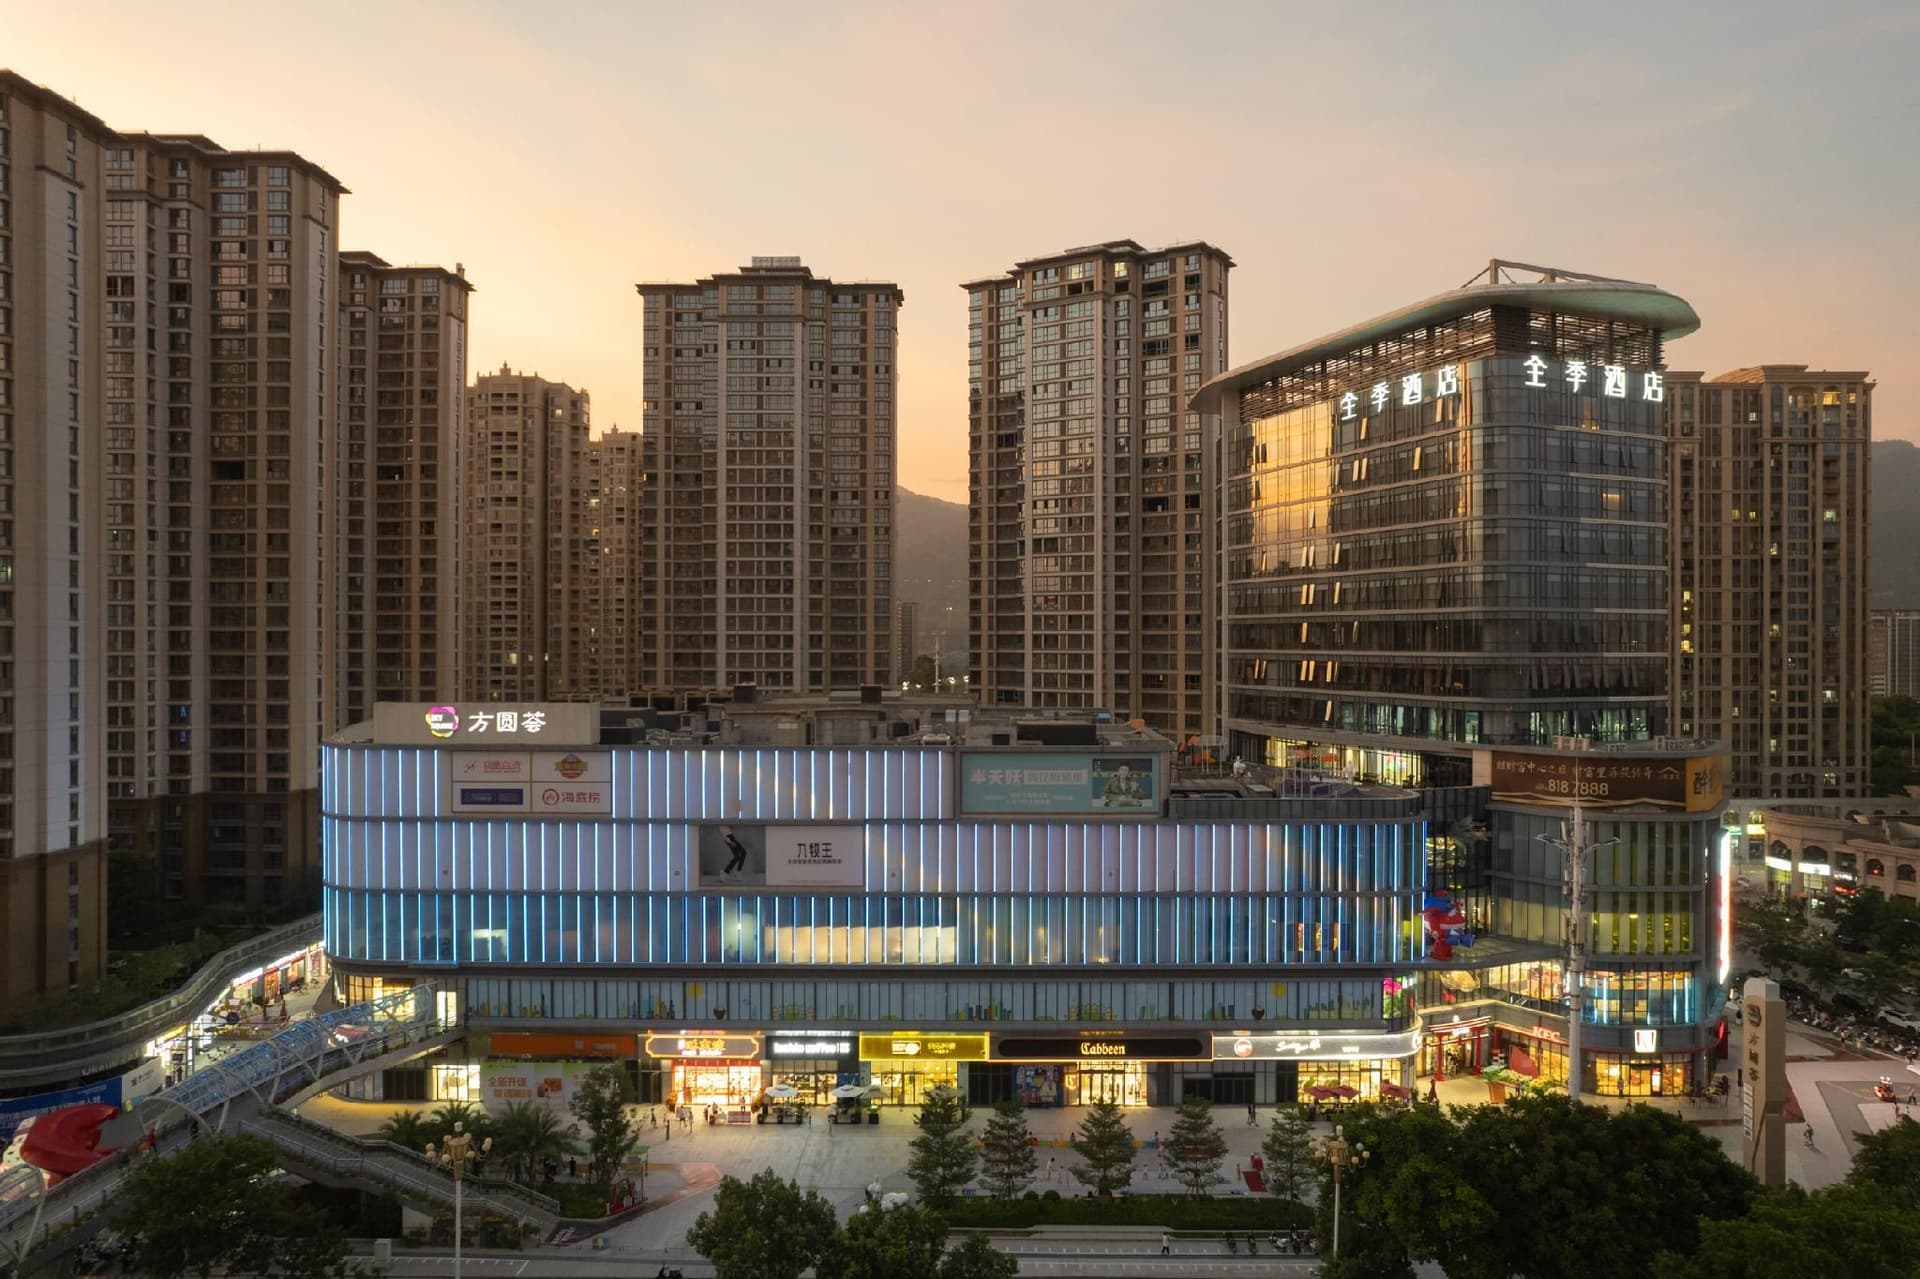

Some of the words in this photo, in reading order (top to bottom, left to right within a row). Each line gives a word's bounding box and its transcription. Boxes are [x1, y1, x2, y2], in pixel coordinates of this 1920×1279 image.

[1523, 355, 1664, 403] 全季酒店
[1340, 365, 1460, 421] 全季酒店
[468, 711, 547, 733] 方圆荟
[1532, 1026, 1560, 1041] KFC
[1081, 1041, 1126, 1056] Cabbeen
